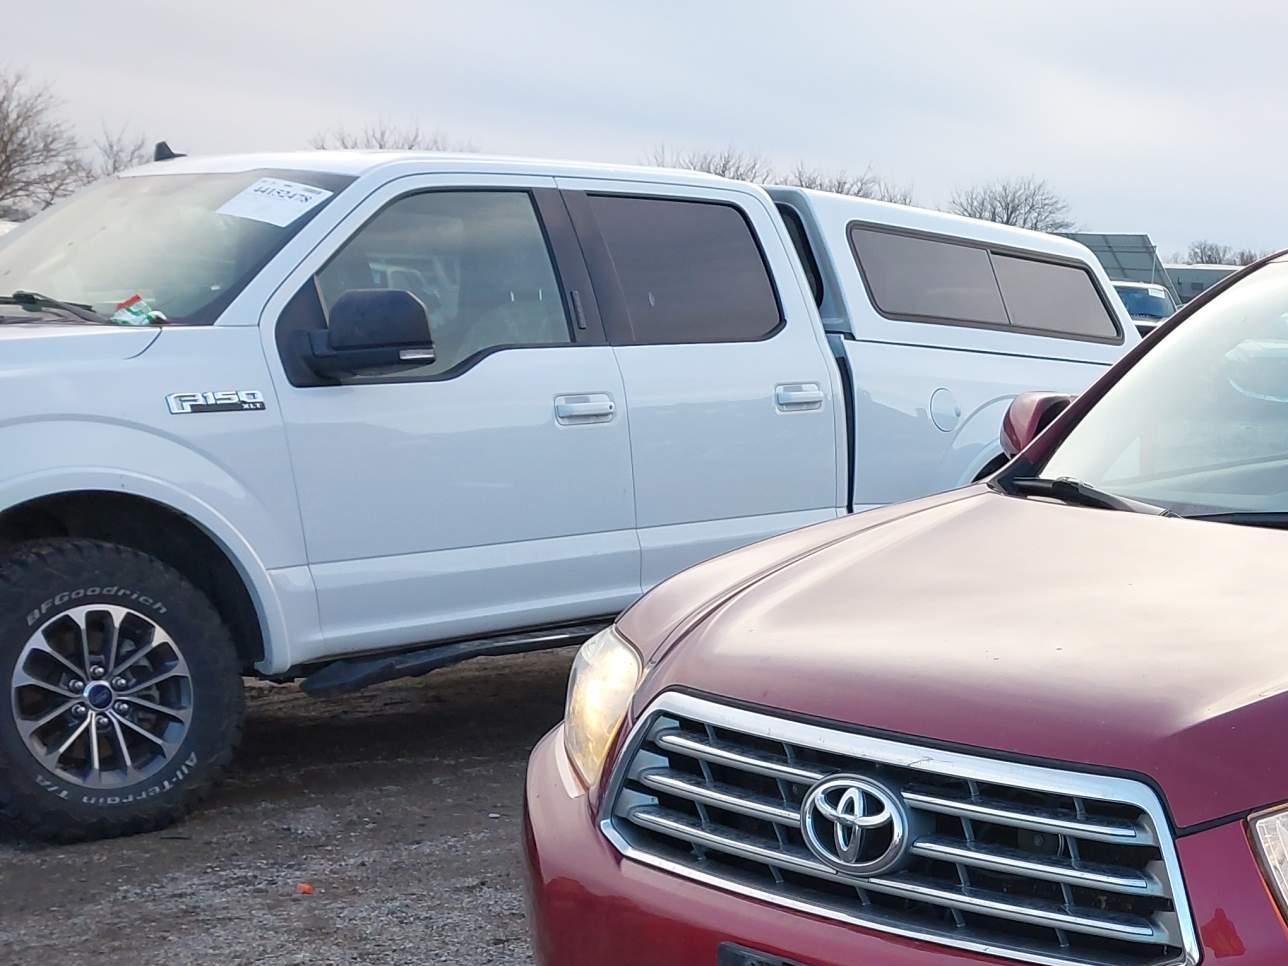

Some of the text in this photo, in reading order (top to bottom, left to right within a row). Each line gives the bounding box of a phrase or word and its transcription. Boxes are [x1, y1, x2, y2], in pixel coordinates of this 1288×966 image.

[26, 586, 168, 626] BFGoodrich
[34, 751, 198, 804] All-Terrain T/A
